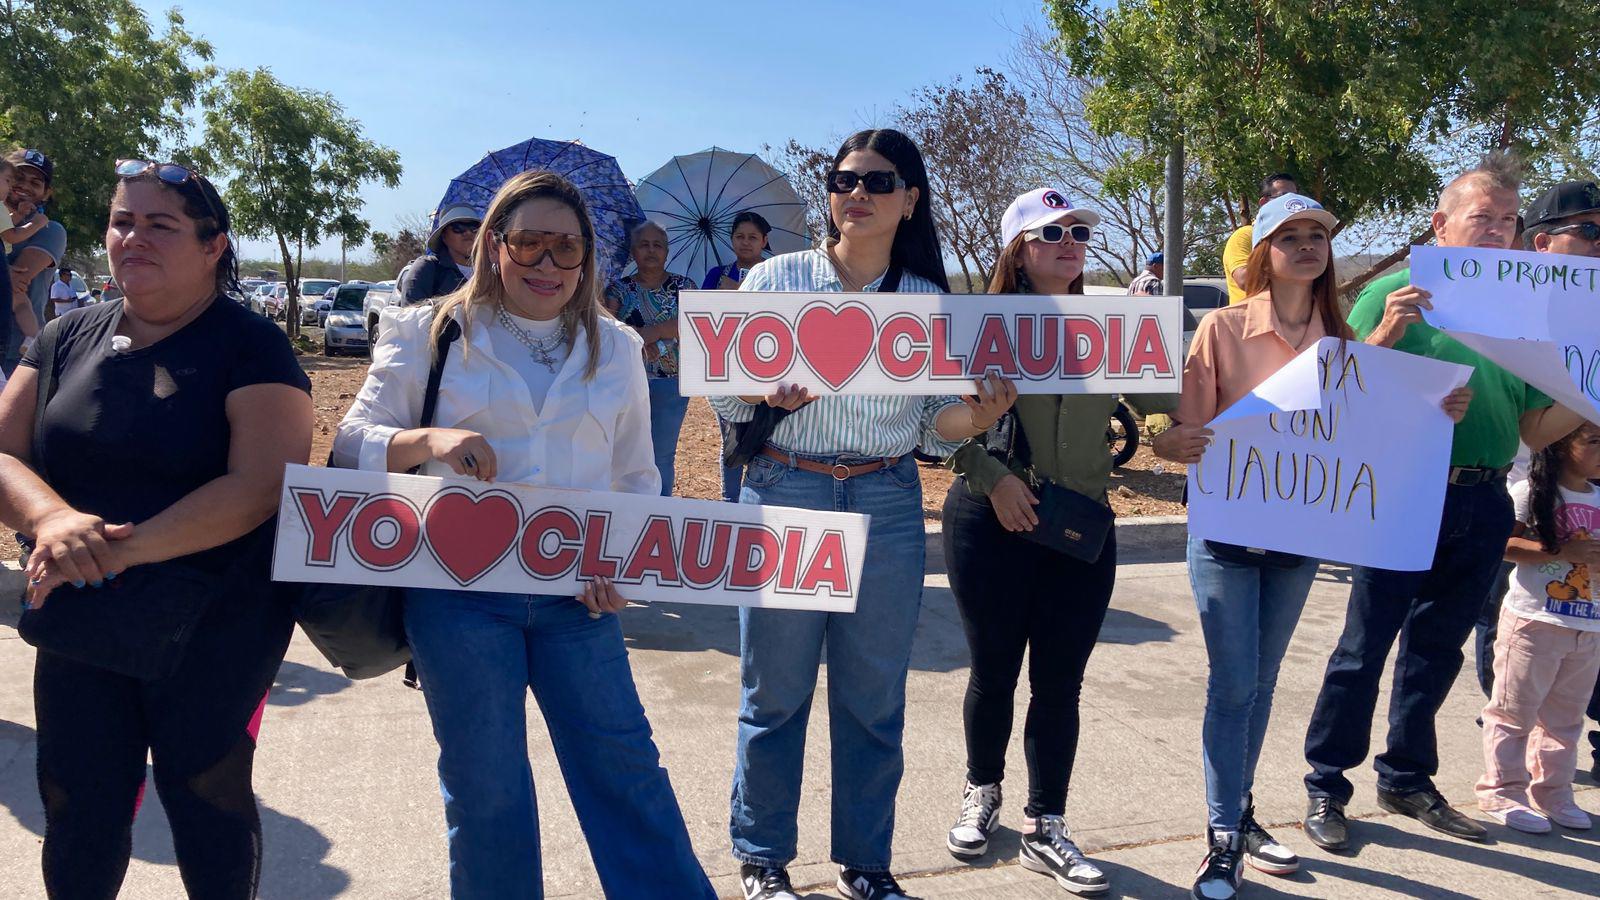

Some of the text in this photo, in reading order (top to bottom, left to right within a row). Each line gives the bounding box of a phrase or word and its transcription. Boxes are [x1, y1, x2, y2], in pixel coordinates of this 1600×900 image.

[1443, 257, 1600, 292] LO PROMET
[684, 311, 1175, 382] YO CLAUDIA
[1269, 402, 1340, 443] CON
[288, 486, 853, 599] YO CLAUDIA
[1569, 602, 1589, 617] THE
